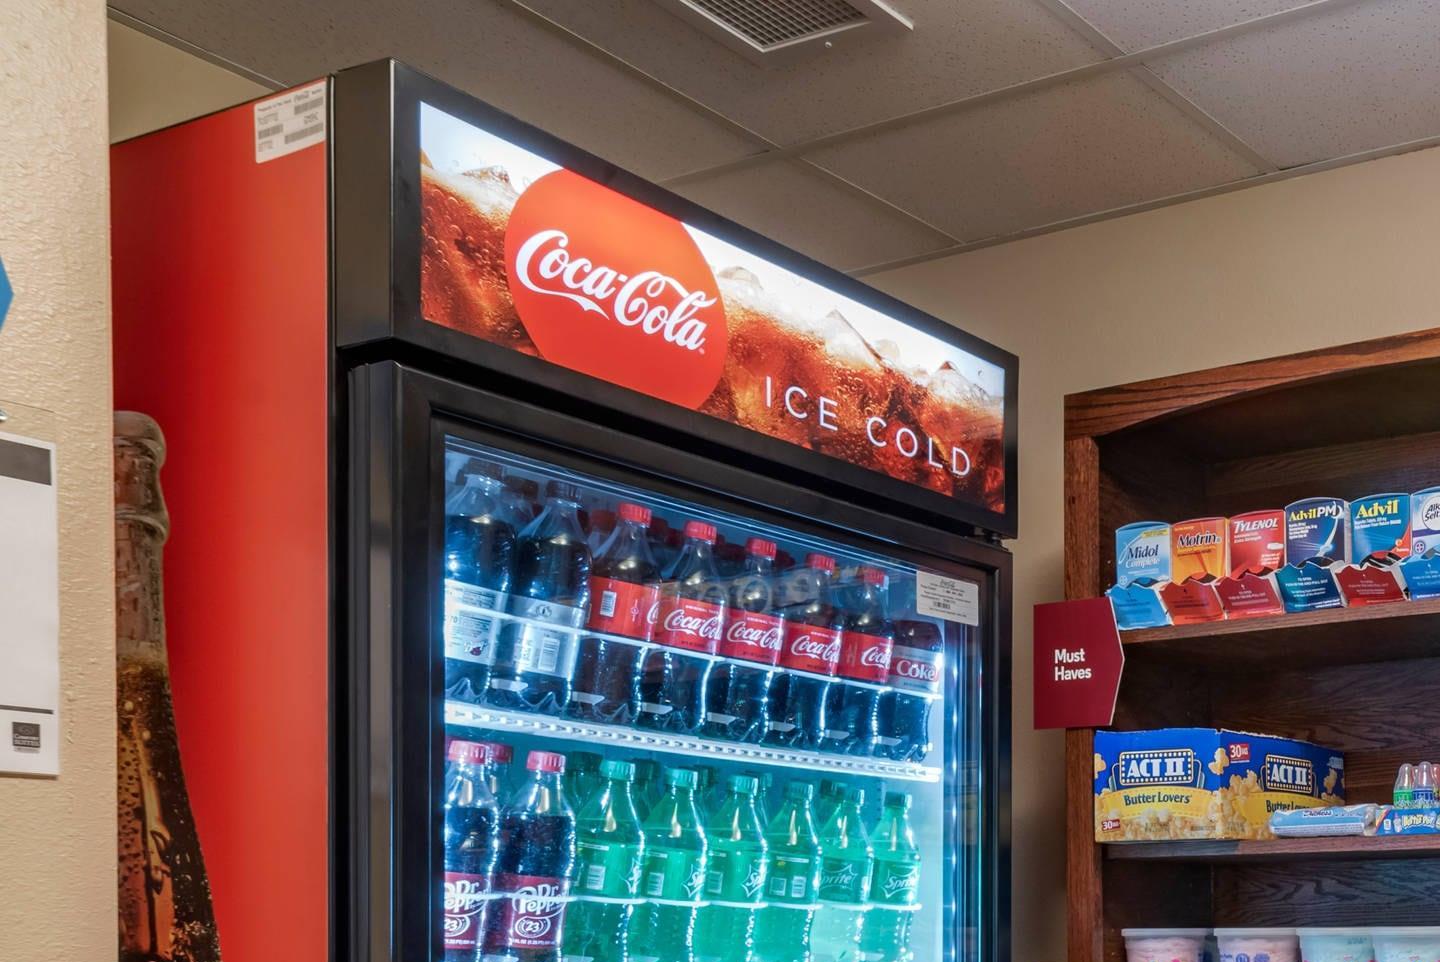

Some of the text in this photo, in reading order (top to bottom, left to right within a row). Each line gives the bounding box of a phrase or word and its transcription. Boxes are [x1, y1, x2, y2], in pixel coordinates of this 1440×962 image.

[514, 228, 718, 352] Coca-Cola
[765, 376, 973, 478] ICE COLD
[1288, 505, 1337, 522] Advil PM
[1356, 499, 1399, 519] Advil
[1234, 518, 1279, 533] TYLENOL
[1177, 531, 1217, 547] Motrin
[1127, 544, 1159, 560] Midol
[1054, 648, 1086, 664] Must
[897, 659, 937, 681] Coke
[1054, 666, 1092, 681] Haves
[1230, 745, 1241, 758] 30
[1127, 757, 1185, 779] ACT II
[1271, 766, 1308, 785] ACT II
[1124, 791, 1190, 806] Butter Lovers
[1101, 820, 1114, 830] 30
[818, 868, 858, 888] prite
[456, 880, 480, 896] Dr
[538, 883, 560, 898] Dr
[525, 919, 541, 932] 23
